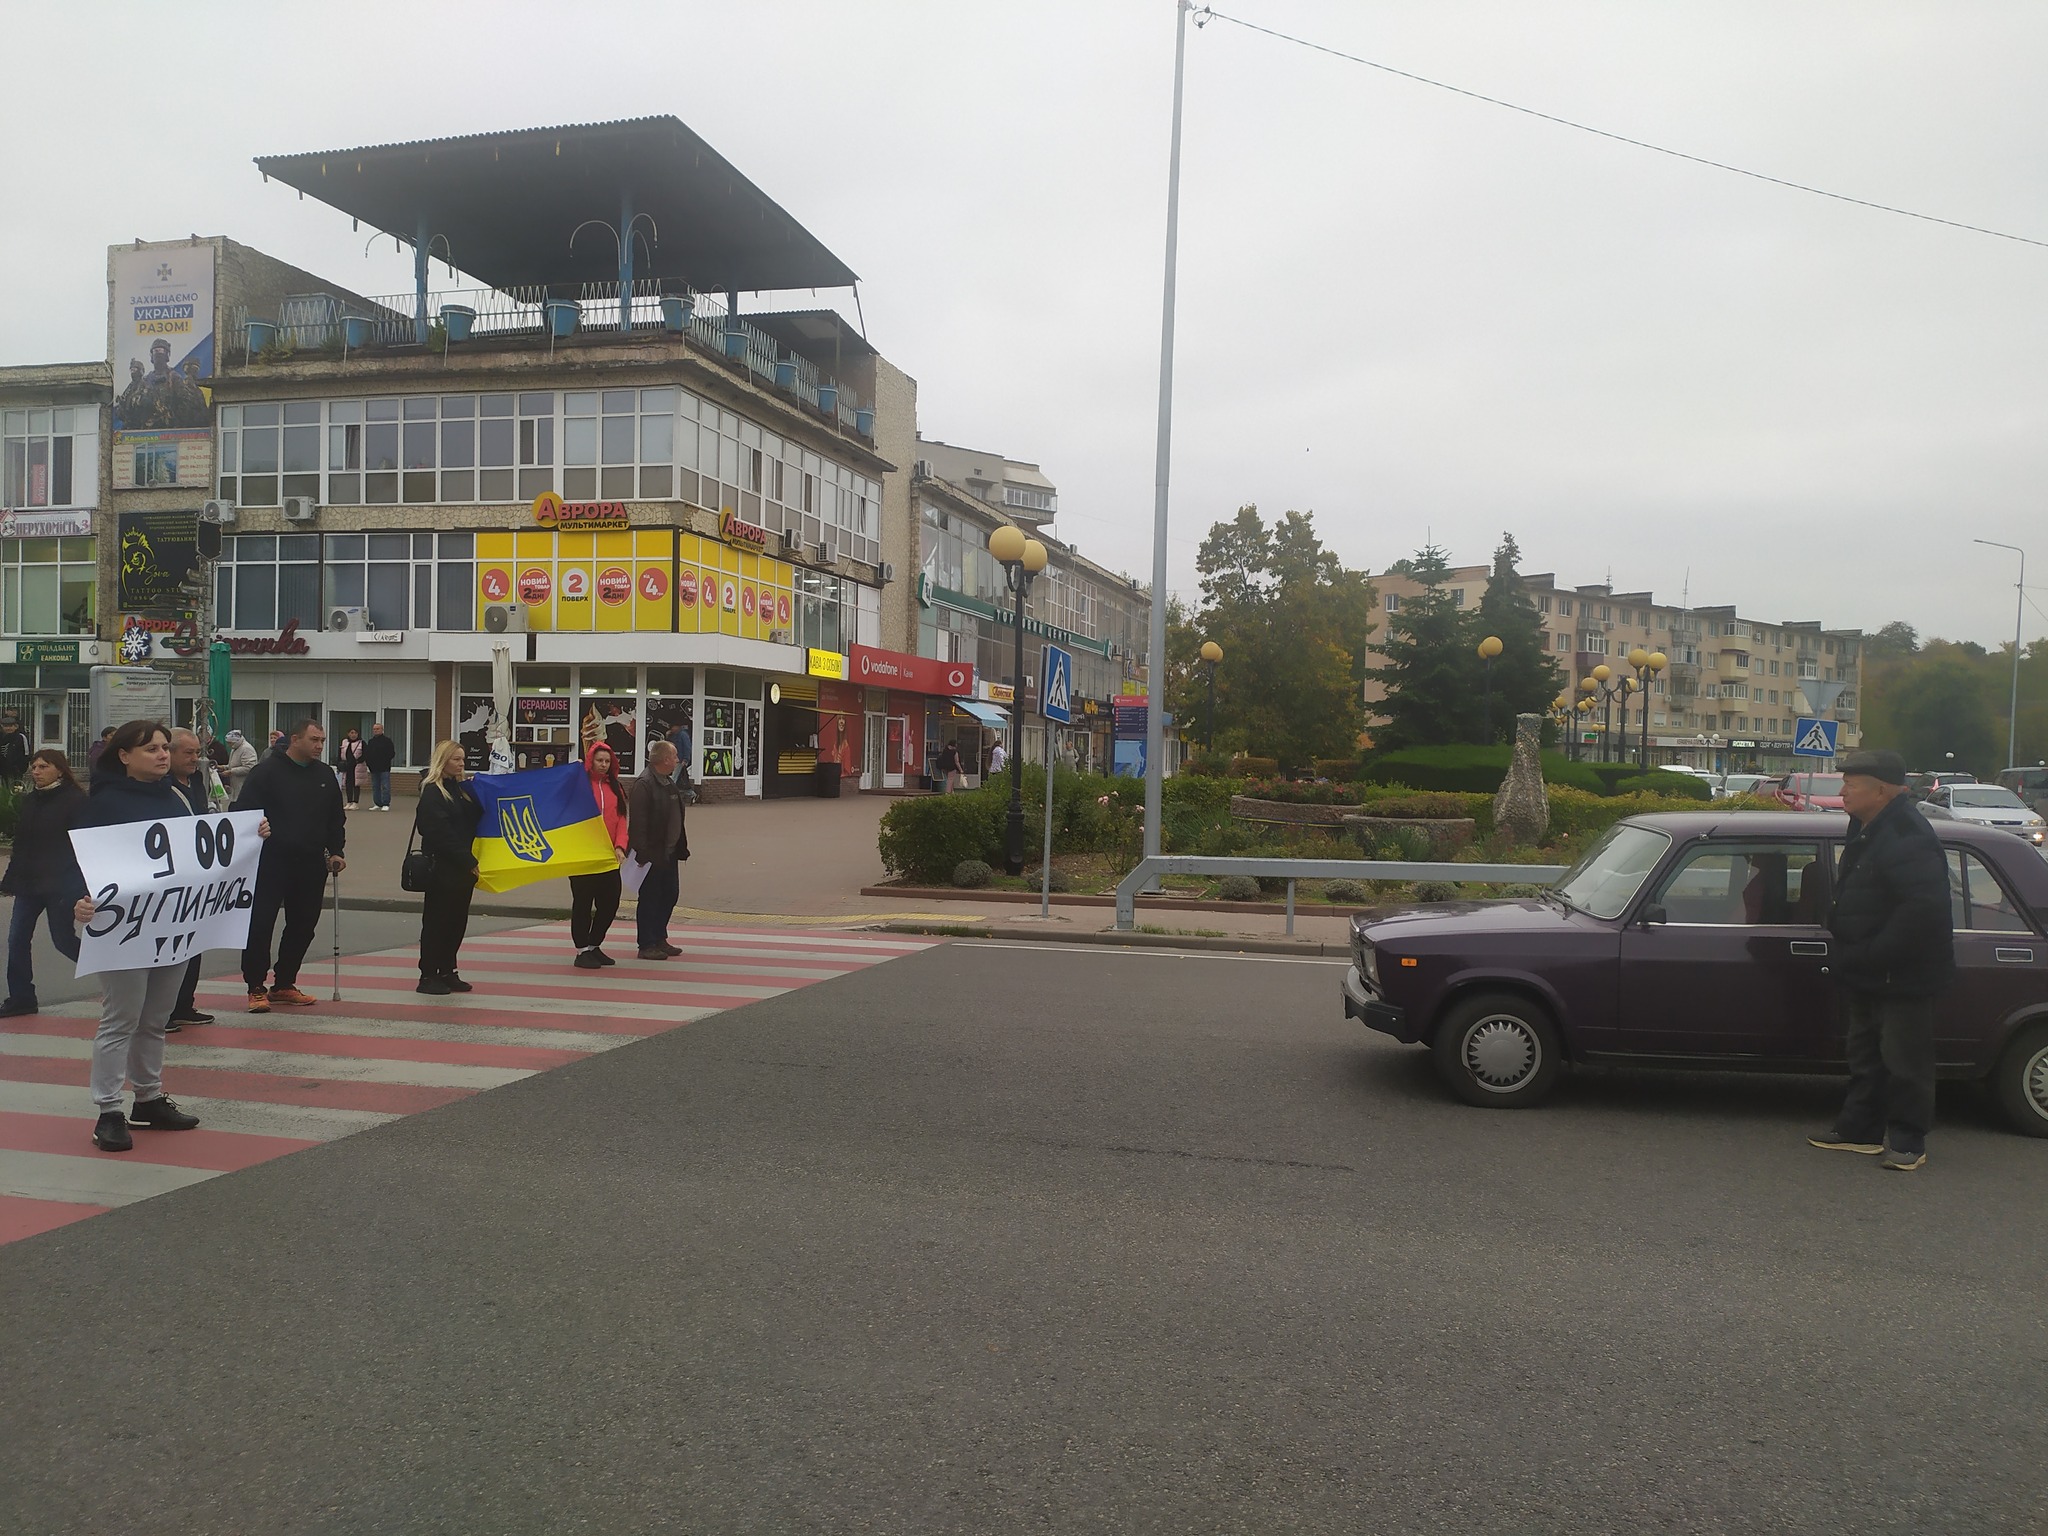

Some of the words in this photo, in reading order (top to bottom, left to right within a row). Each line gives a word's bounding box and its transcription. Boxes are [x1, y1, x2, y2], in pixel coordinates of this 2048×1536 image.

[130, 292, 198, 305] ЗАХИЩАЄМО
[136, 305, 191, 320] УКРАЇНУ
[139, 321, 189, 333] РАЗОМ!
[537, 498, 628, 520] АВРОРА
[16, 520, 81, 535] НЕРУХОМІСТЬ
[560, 521, 629, 529] МУЛЬТИМАРКЕТ
[724, 512, 767, 544] АВРОРА
[488, 578, 500, 596] 4
[520, 576, 548, 586] НОВИЙ
[568, 574, 583, 593] 2
[600, 574, 628, 586] НОВИЙ
[646, 578, 658, 596] 4
[524, 588, 532, 599] 2
[602, 587, 612, 599] 2
[706, 586, 712, 602] 4
[726, 586, 732, 605] 2
[746, 596, 752, 612] 4
[780, 604, 786, 620] 4
[125, 616, 178, 631] АВРОРА
[996, 608, 1043, 634] ТОРОВИЙ
[37, 644, 76, 652] ОЩАДБАНК
[810, 656, 822, 669] КАВА
[871, 661, 898, 676] vodafone
[518, 700, 568, 710] ICEPARADISE
[1732, 740, 1756, 748] ROZETKA
[144, 822, 175, 878] 9
